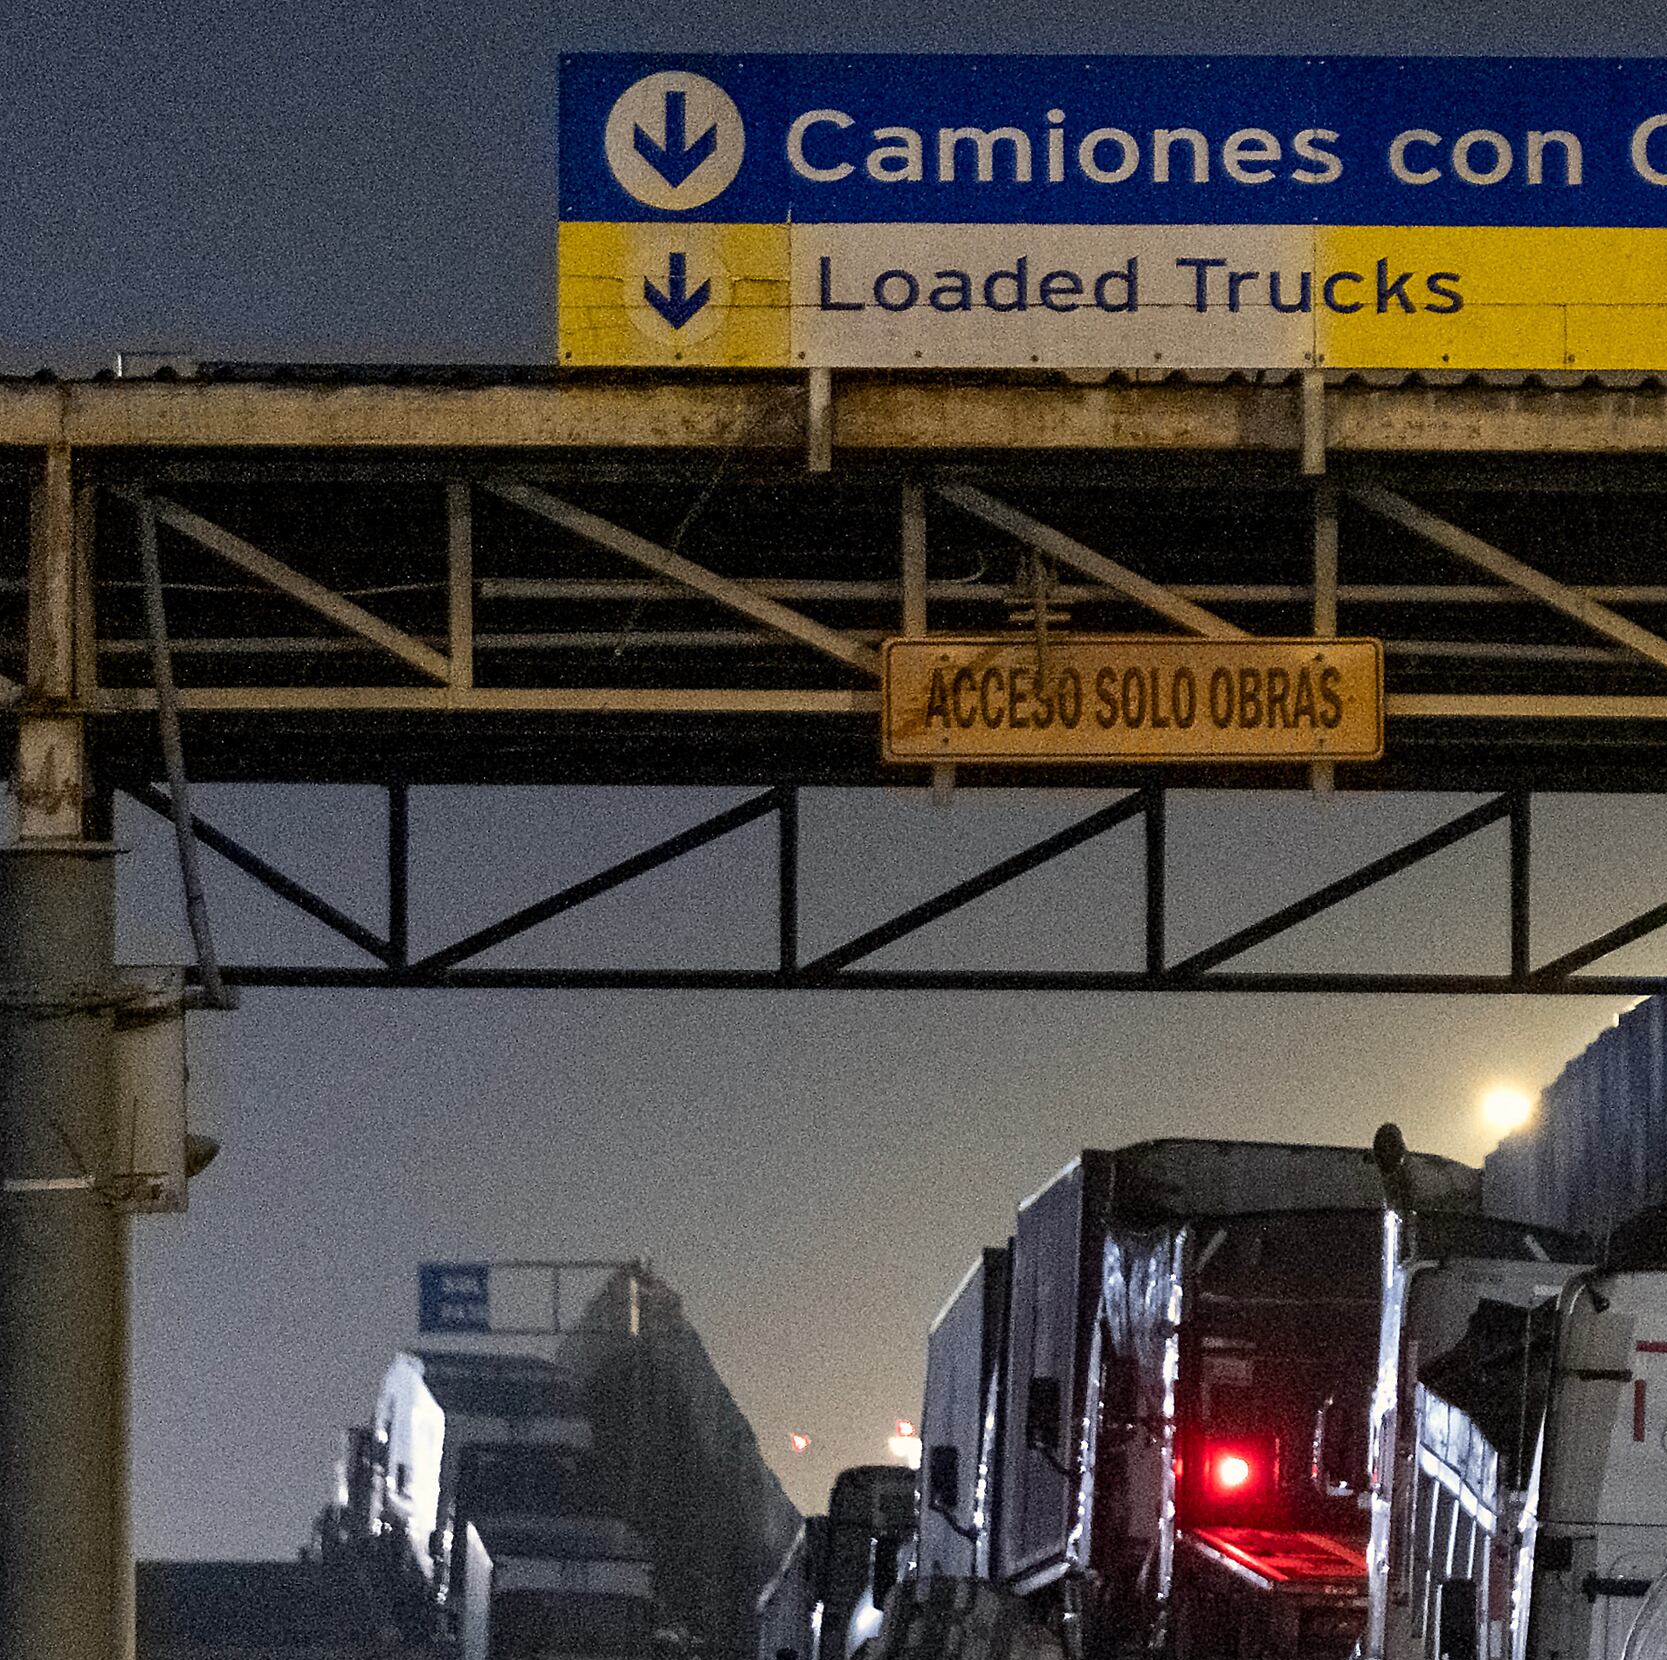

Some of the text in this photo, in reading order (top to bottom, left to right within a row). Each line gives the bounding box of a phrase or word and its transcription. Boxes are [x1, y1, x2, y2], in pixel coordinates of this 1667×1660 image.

[786, 108, 1343, 185] Camiones
[1388, 129, 1584, 186] con
[818, 256, 1465, 314] Loaded Trucks
[925, 665, 1345, 731] ACCESO SOLO OBRAS
